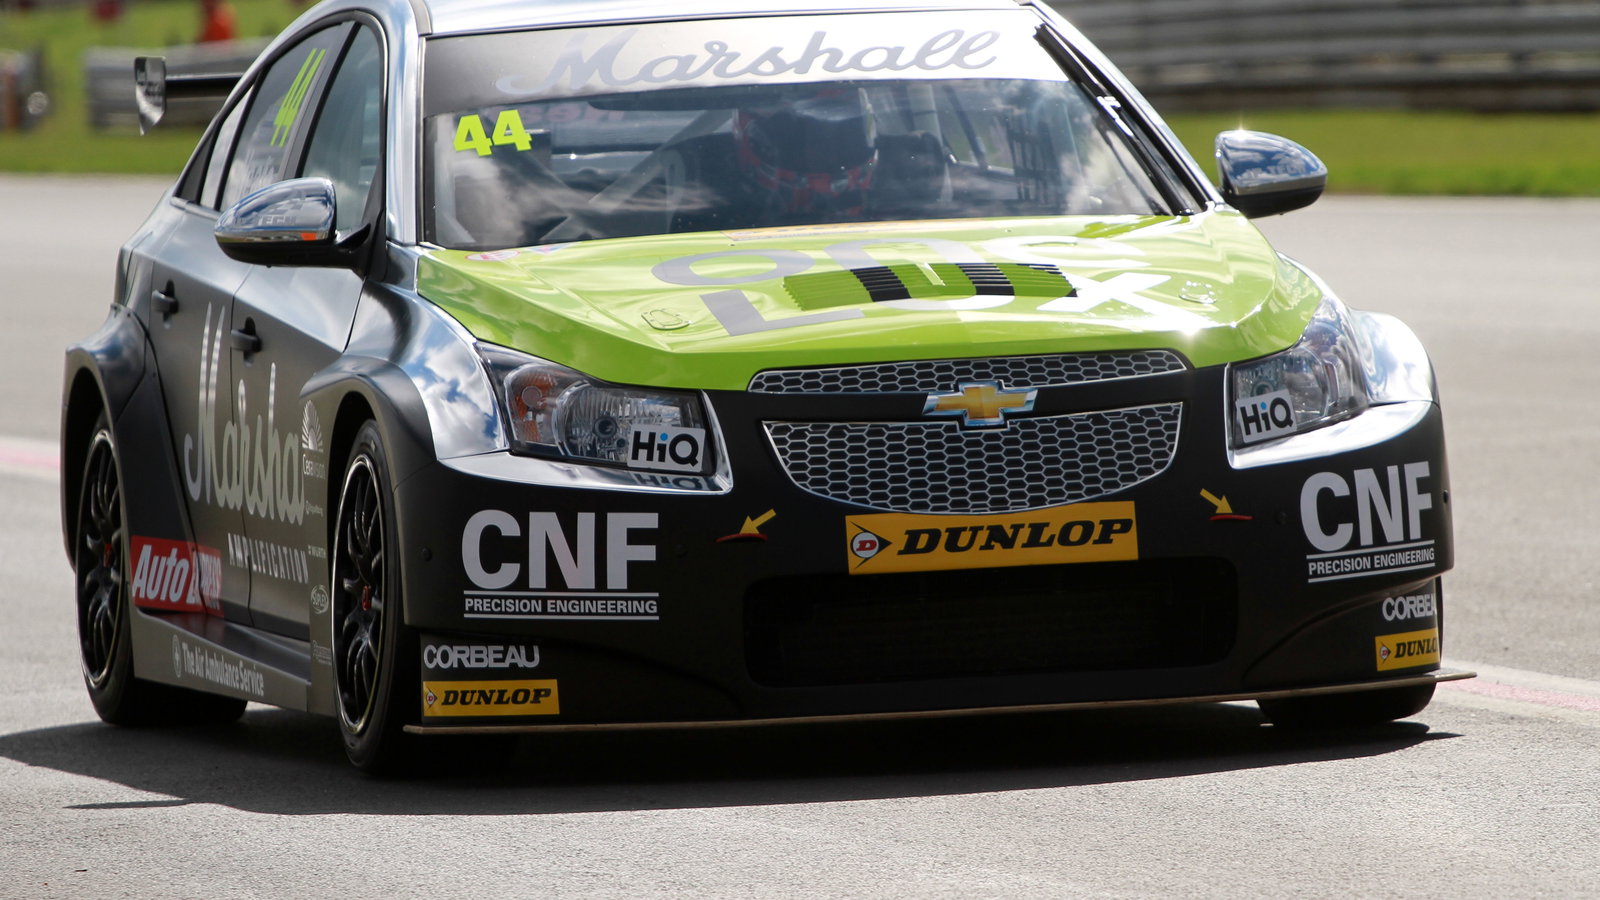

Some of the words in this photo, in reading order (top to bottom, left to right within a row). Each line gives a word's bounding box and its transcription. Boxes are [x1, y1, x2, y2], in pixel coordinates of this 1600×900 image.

[498, 28, 1000, 94] Marshall
[270, 48, 326, 147] 44
[453, 108, 532, 157] 44
[184, 302, 304, 526] Marsha
[1239, 396, 1294, 436] HiQ
[631, 430, 699, 467] HiQ
[1300, 461, 1433, 551] CNF
[461, 509, 659, 589] CNF
[897, 518, 1134, 556] DUNLOP
[131, 544, 190, 603] Auto
[1308, 556, 1371, 575] PRECISION
[1373, 547, 1435, 569] ENGINEERING
[465, 599, 542, 613] PRECISION
[547, 599, 658, 614] ENGINEERING
[423, 645, 540, 669] CORBEAU
[441, 687, 552, 706] DUNLOP
